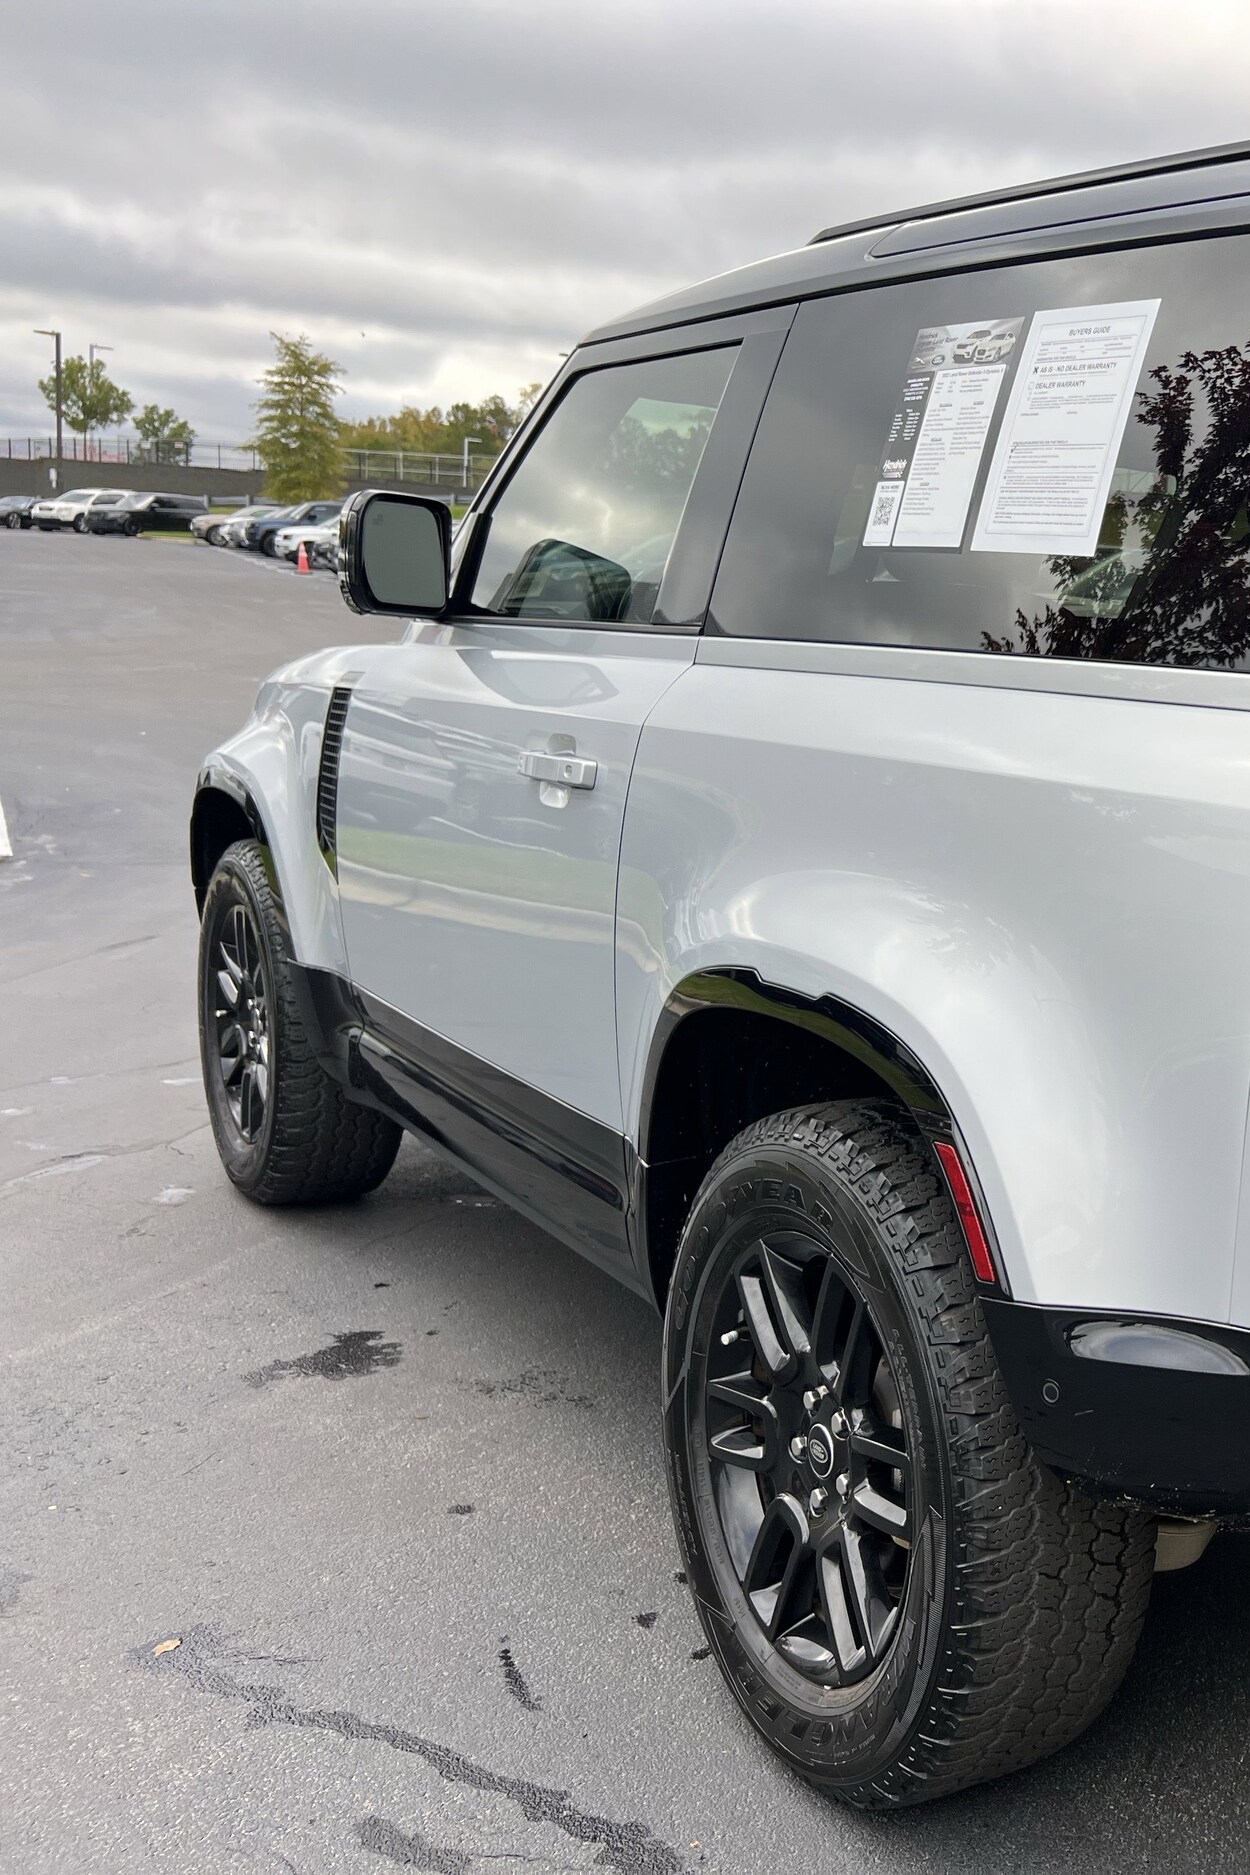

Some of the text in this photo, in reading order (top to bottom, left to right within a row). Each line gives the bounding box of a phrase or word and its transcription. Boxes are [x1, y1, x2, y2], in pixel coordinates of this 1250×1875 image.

[1069, 326, 1112, 336] BUYERS GUIDE
[1065, 363, 1087, 372] DEALER
[1087, 362, 1118, 370] WARRANTY
[1035, 380, 1087, 390] DEALER WARRANTY
[674, 1178, 834, 1331] GOODYEAR
[736, 1617, 917, 1747] WRANGLER
